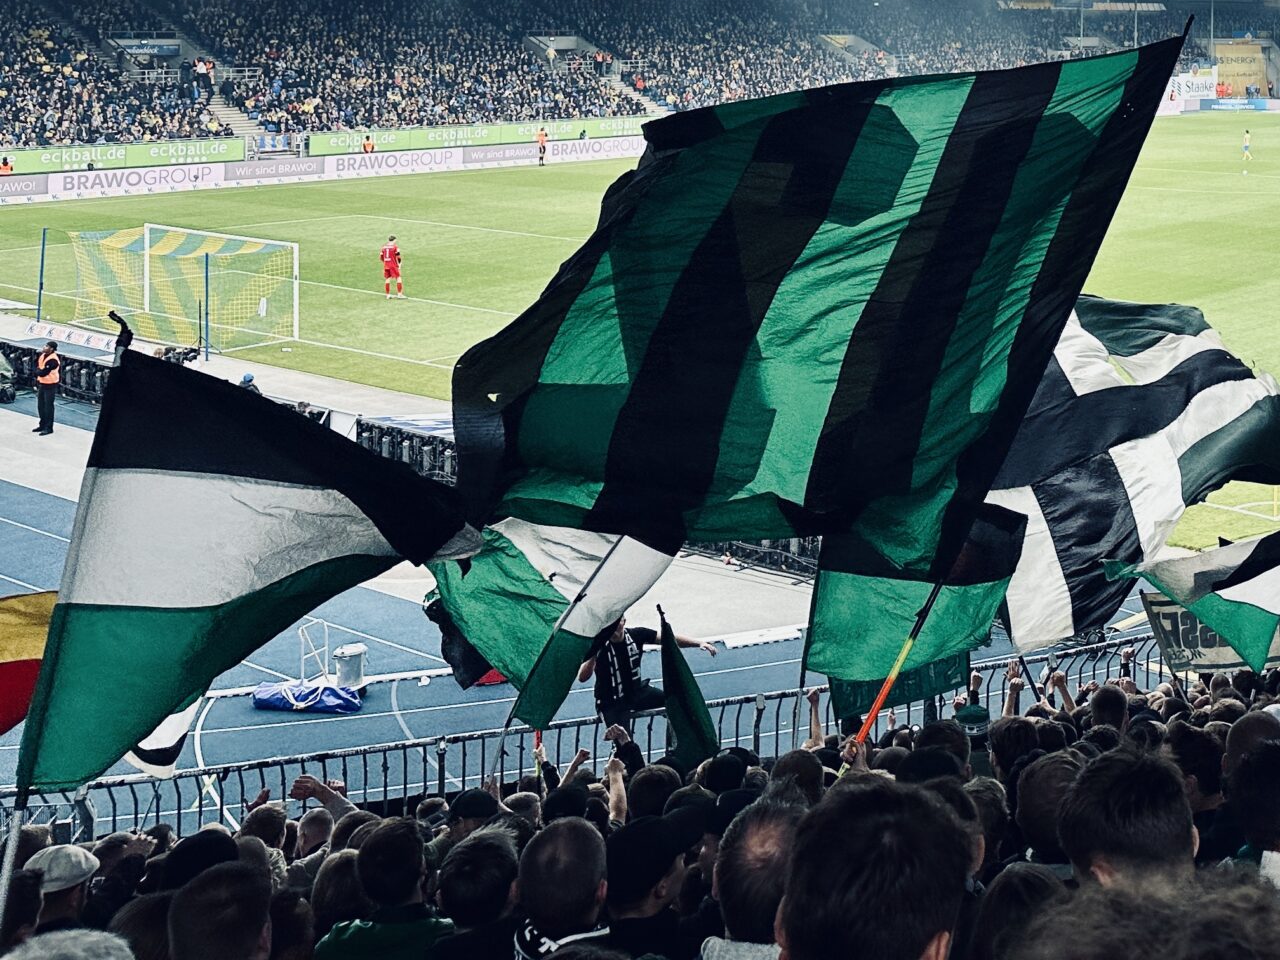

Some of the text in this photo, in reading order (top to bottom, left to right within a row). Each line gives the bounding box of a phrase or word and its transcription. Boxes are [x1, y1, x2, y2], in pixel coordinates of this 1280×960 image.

[1185, 80, 1215, 93] Staake
[427, 126, 488, 141] eckball.de
[40, 145, 126, 164] eckball.de
[150, 140, 228, 158] eckball.de
[486, 149, 504, 159] sind
[335, 150, 453, 172] BRAWOGROUP
[235, 163, 317, 177] Wir sind BRAWO!
[62, 166, 212, 191] BRAWOGROUP
